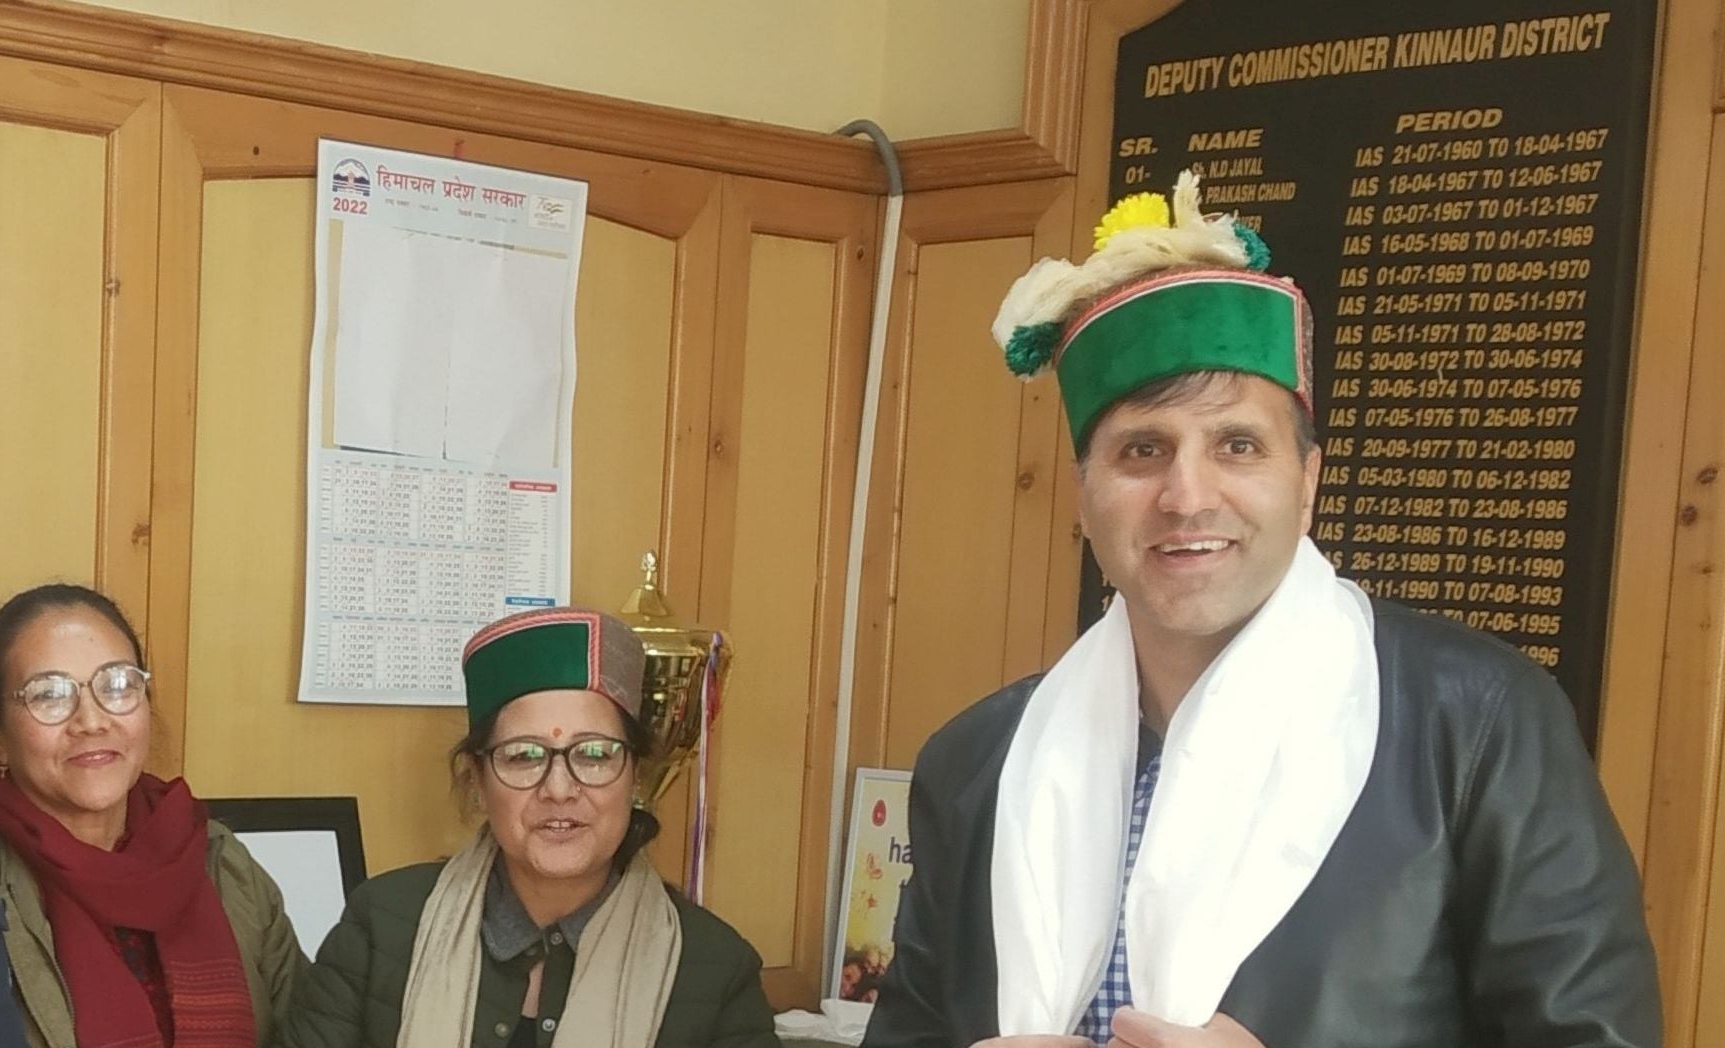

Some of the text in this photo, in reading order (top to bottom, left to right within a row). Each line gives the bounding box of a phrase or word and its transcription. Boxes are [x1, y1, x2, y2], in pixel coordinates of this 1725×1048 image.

[1144, 12, 1610, 98] DEPUTY COMMISSIONER KINNAUR DISTRICT
[1118, 108, 1503, 157] SR. NAME PERIOD
[1229, 157, 1263, 177] JAYAL
[1355, 146, 1384, 168] IAS
[1488, 137, 1509, 158] TO
[376, 165, 526, 209] हिमाचल प्रदेश सरकार
[1206, 184, 1257, 204] PRAKASH
[1257, 182, 1296, 201] CHAND
[1350, 176, 1379, 198] IAS
[1482, 168, 1504, 189] TO
[333, 197, 368, 215] 2022
[1344, 205, 1375, 226] IAS
[1478, 198, 1499, 219] TO
[1342, 234, 1372, 256] IAS
[1475, 230, 1496, 251] TO
[1340, 267, 1368, 288] IAS
[1472, 263, 1493, 283] TO
[1337, 295, 1366, 316] IAS
[1468, 291, 1489, 312] TO
[1334, 324, 1364, 345] IAS
[1465, 322, 1486, 343] TO
[1334, 350, 1364, 370] IAS
[1463, 349, 1485, 369] TO
[1332, 378, 1360, 398] IAS
[1462, 378, 1483, 398] TO
[1328, 407, 1357, 427] IAS
[1459, 407, 1479, 427] TO
[1327, 437, 1355, 457] IAS
[1456, 439, 1477, 459] TO
[1322, 466, 1350, 486] IAS
[1452, 468, 1473, 489] TO
[1318, 495, 1347, 515] IAS
[1448, 498, 1469, 518] TO
[1317, 522, 1345, 542] IAS
[1446, 525, 1468, 546] TO
[1445, 554, 1466, 573] TO
[1444, 581, 1464, 600] TO
[888, 836, 912, 864] ha
